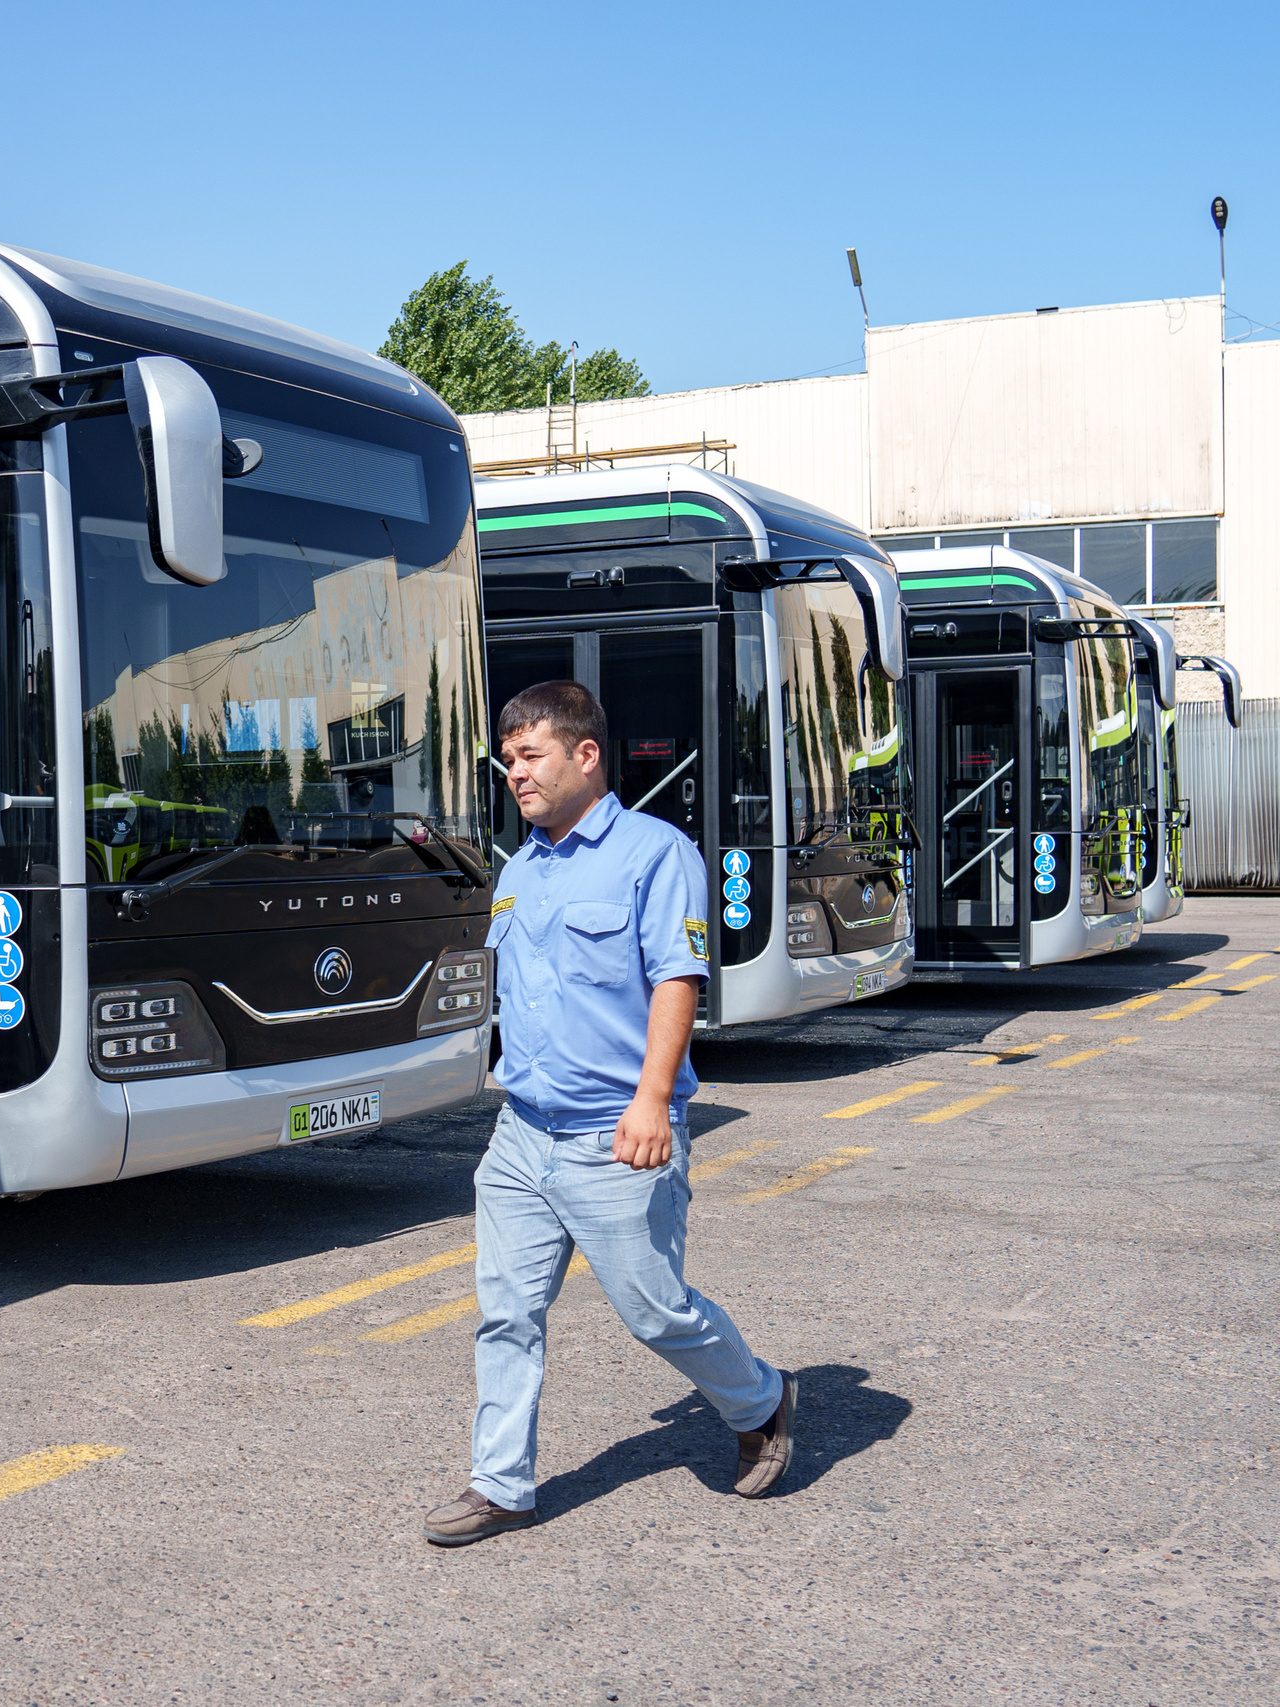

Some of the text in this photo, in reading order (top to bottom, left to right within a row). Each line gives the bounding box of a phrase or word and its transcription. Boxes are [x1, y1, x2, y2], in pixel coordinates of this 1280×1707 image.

[259, 892, 402, 912] YUTONG
[294, 1097, 371, 1132] 01 206 NKA
